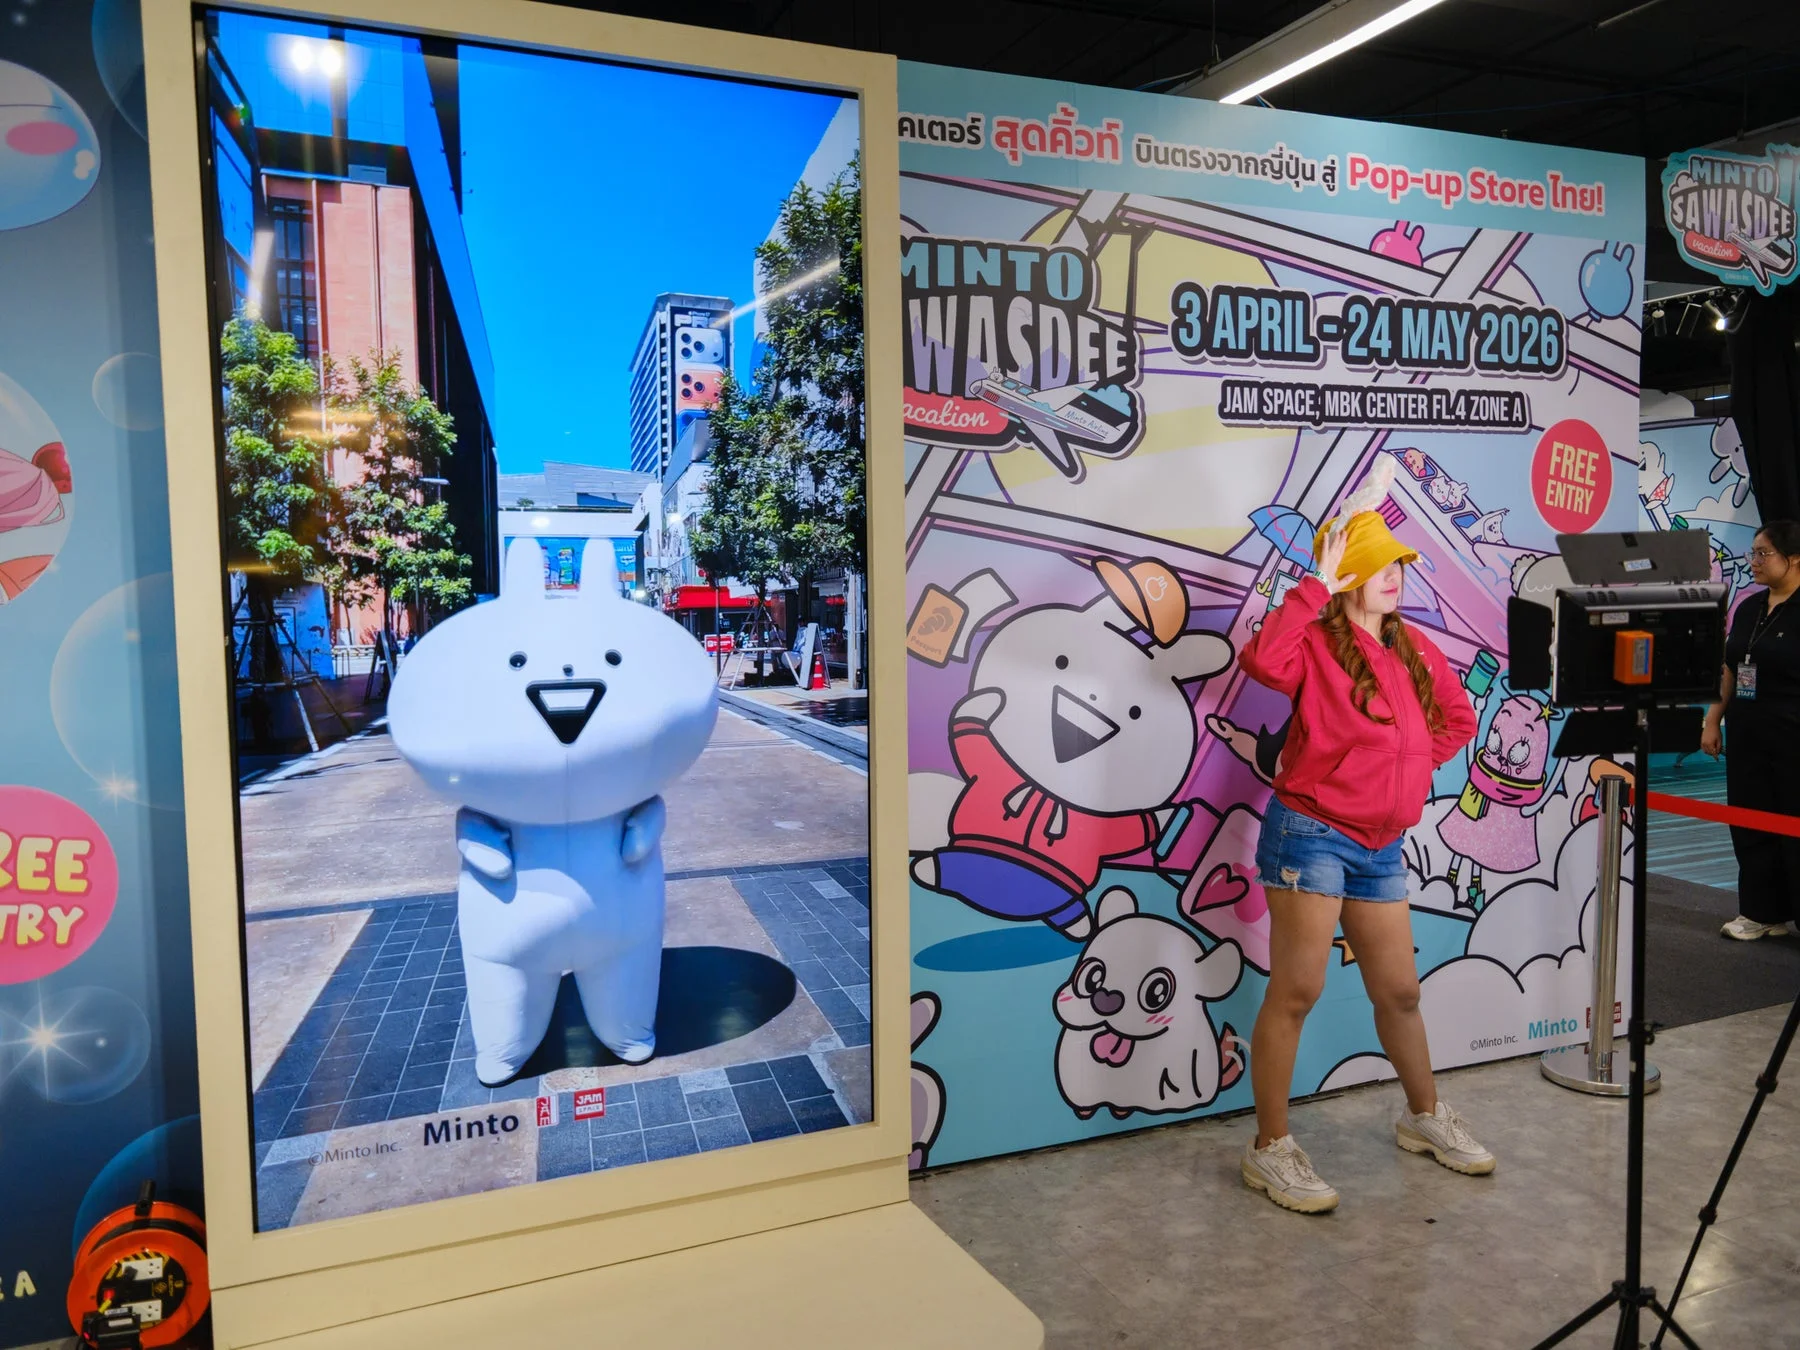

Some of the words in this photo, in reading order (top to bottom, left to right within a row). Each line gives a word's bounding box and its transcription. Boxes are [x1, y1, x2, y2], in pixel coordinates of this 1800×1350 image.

[898, 116, 982, 145] คเตอร์
[995, 106, 1120, 161] สุดคิ้วท์
[1135, 138, 1316, 188] บินตรงจากญี่ปุ่น
[1321, 158, 1336, 192] สู่
[1350, 156, 1462, 205] Pop-up
[1469, 170, 1544, 207] Store
[1548, 174, 1603, 213] ไทย!
[1691, 159, 1774, 193] MINTO
[1672, 188, 1792, 242] SAWASDEE
[1691, 237, 1734, 258] vacation
[901, 242, 1083, 300] MINTO
[1178, 291, 1202, 348] 3
[1212, 294, 1314, 354] APRIL
[1347, 303, 1393, 358] 24
[1401, 307, 1470, 364] MAY
[1479, 313, 1560, 366] 2026
[1223, 386, 1259, 414] JAM
[1262, 388, 1321, 420] SPACE,
[1325, 393, 1362, 418] MBK
[1366, 394, 1429, 420] CENTER
[1470, 396, 1509, 421] ZONE
[1512, 398, 1523, 422] A
[1549, 441, 1599, 487] FREE
[1545, 479, 1594, 515] ENTRY
[1736, 689, 1755, 698] STAFF
[1504, 1035, 1519, 1046] Inc.
[1528, 1018, 1578, 1040] Minto
[423, 1114, 520, 1146] Minto
[375, 1140, 402, 1156] Inc.
